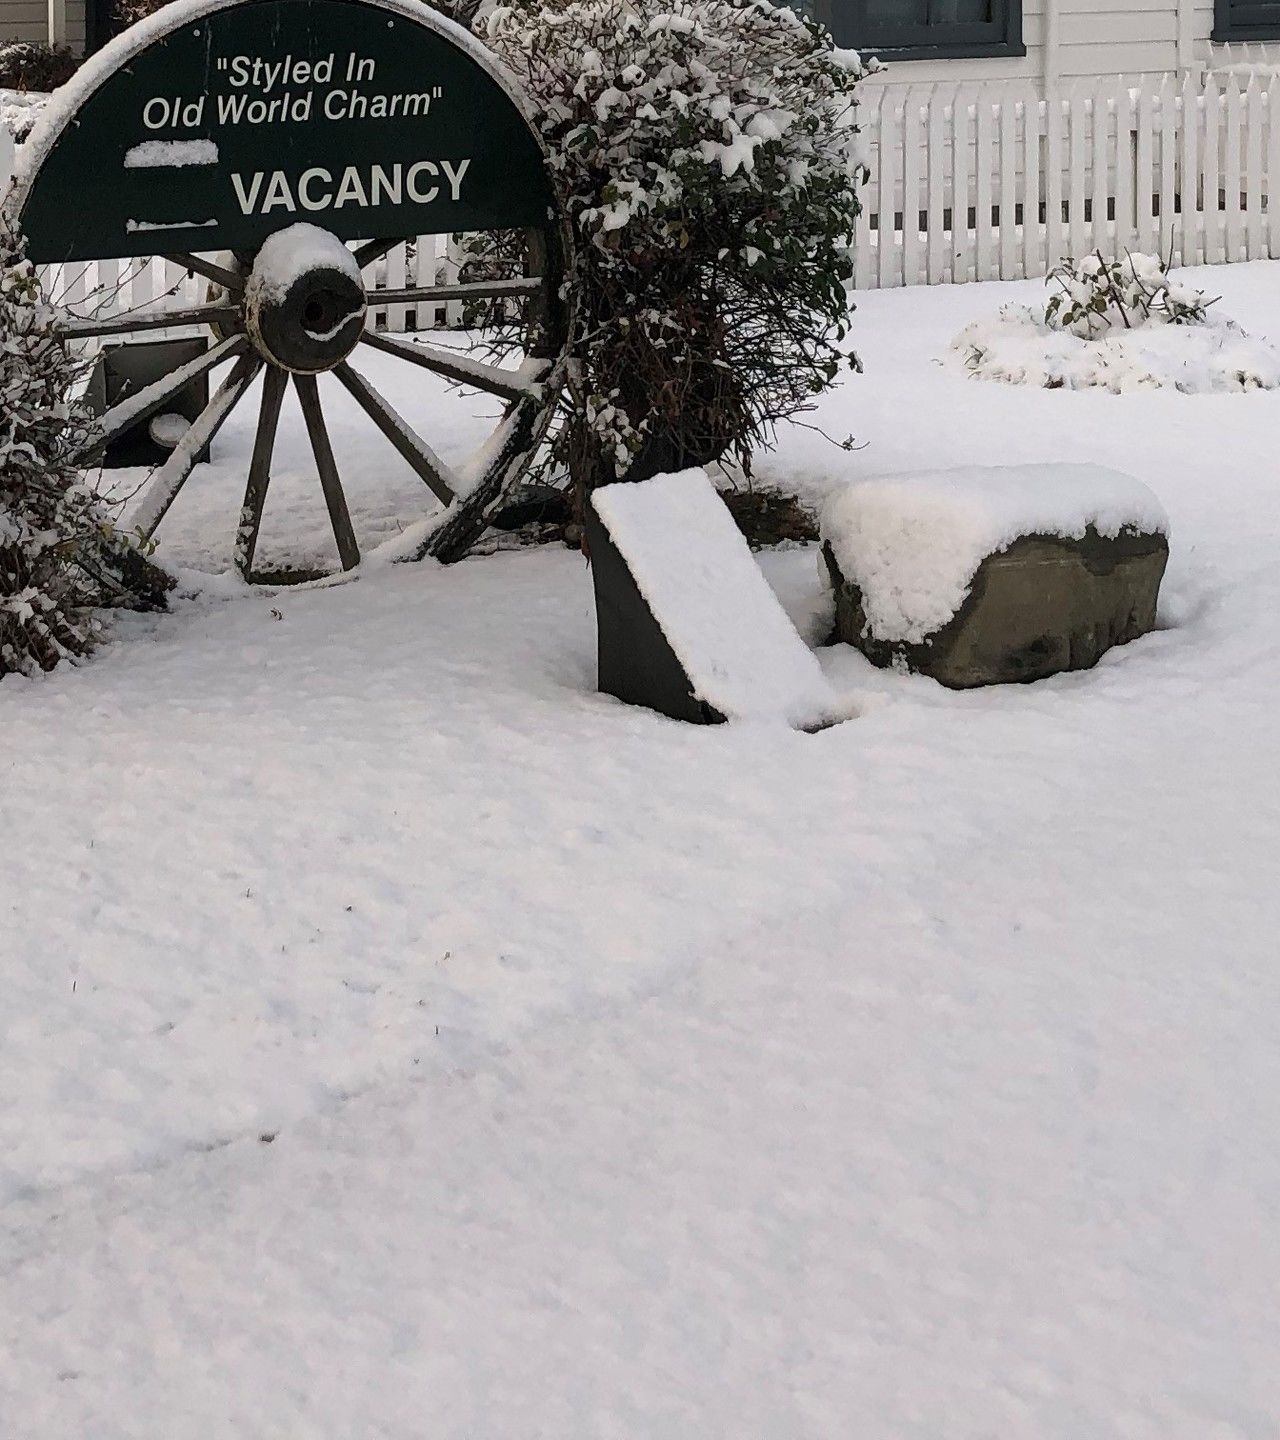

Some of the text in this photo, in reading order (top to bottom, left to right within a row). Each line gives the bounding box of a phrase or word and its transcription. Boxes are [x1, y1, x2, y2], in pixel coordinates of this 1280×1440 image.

[216, 51, 376, 93] "Styled In
[142, 86, 443, 130] Old World Charm"
[230, 159, 472, 216] VACANCY
